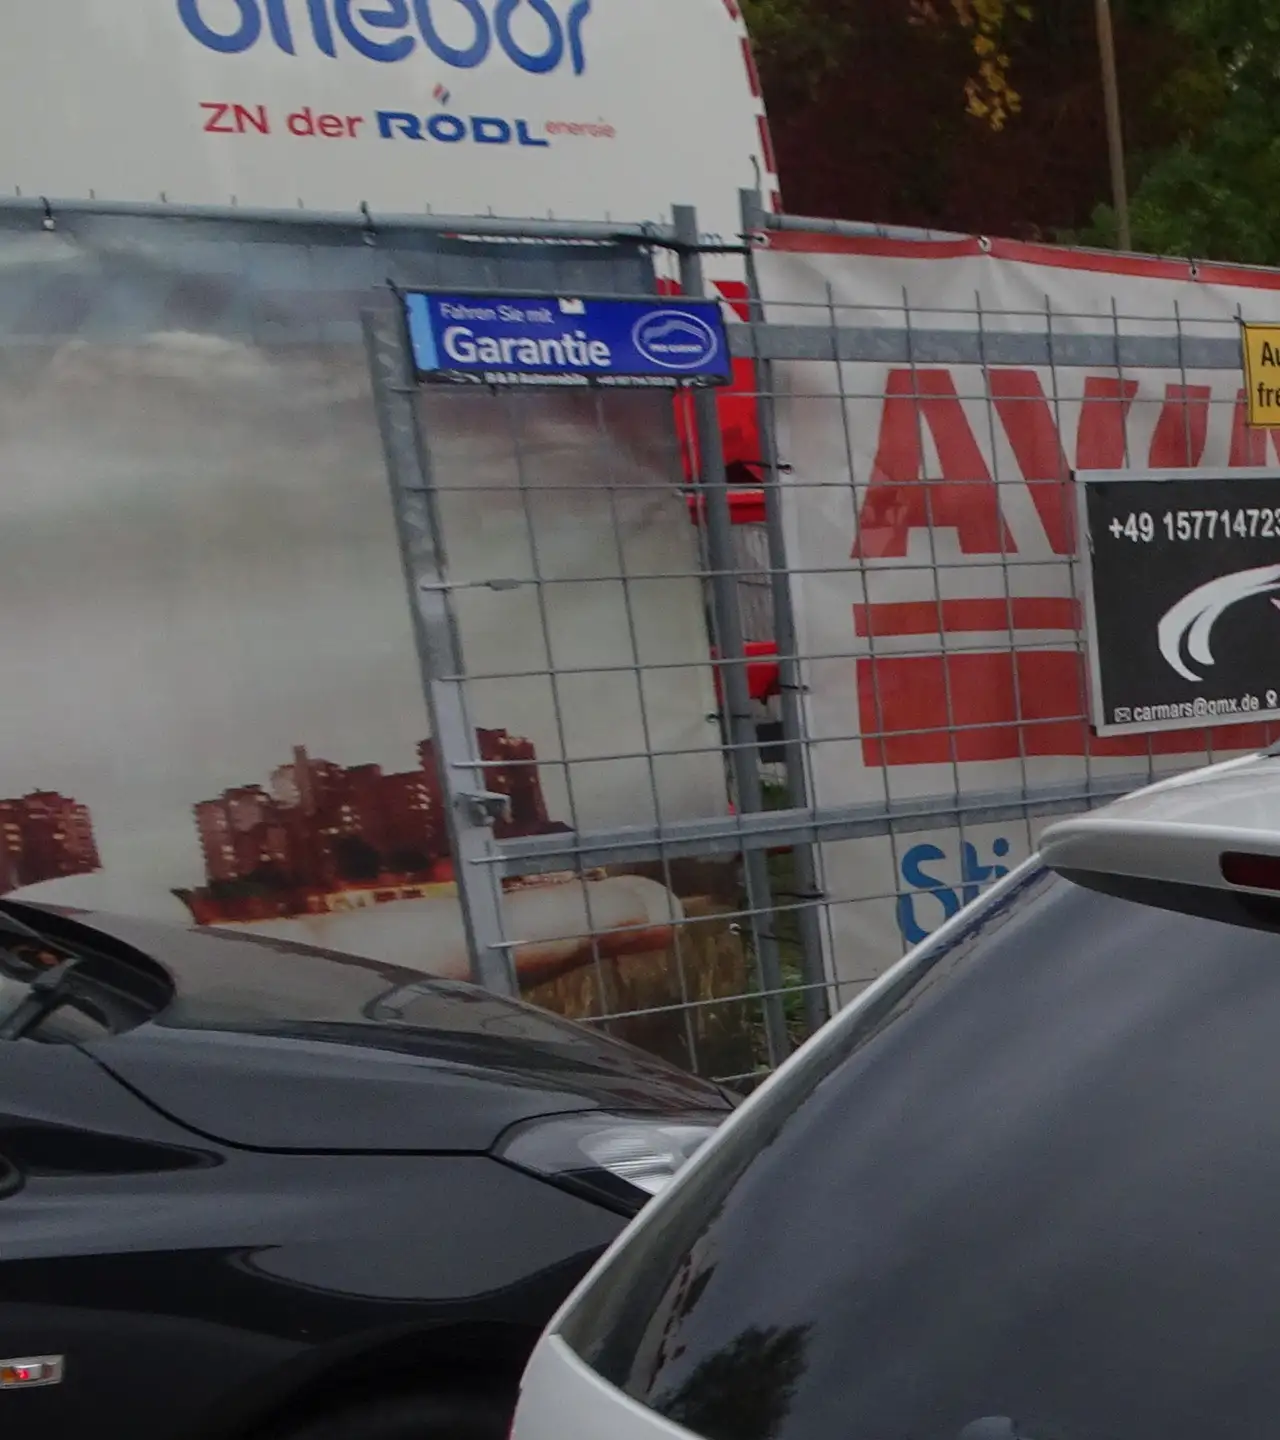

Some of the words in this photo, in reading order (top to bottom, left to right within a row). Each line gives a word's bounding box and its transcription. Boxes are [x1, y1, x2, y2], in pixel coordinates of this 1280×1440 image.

[200, 102, 271, 134] ZN
[286, 107, 362, 138] der
[443, 325, 611, 367] Garantie
[1109, 512, 1154, 542] +49
